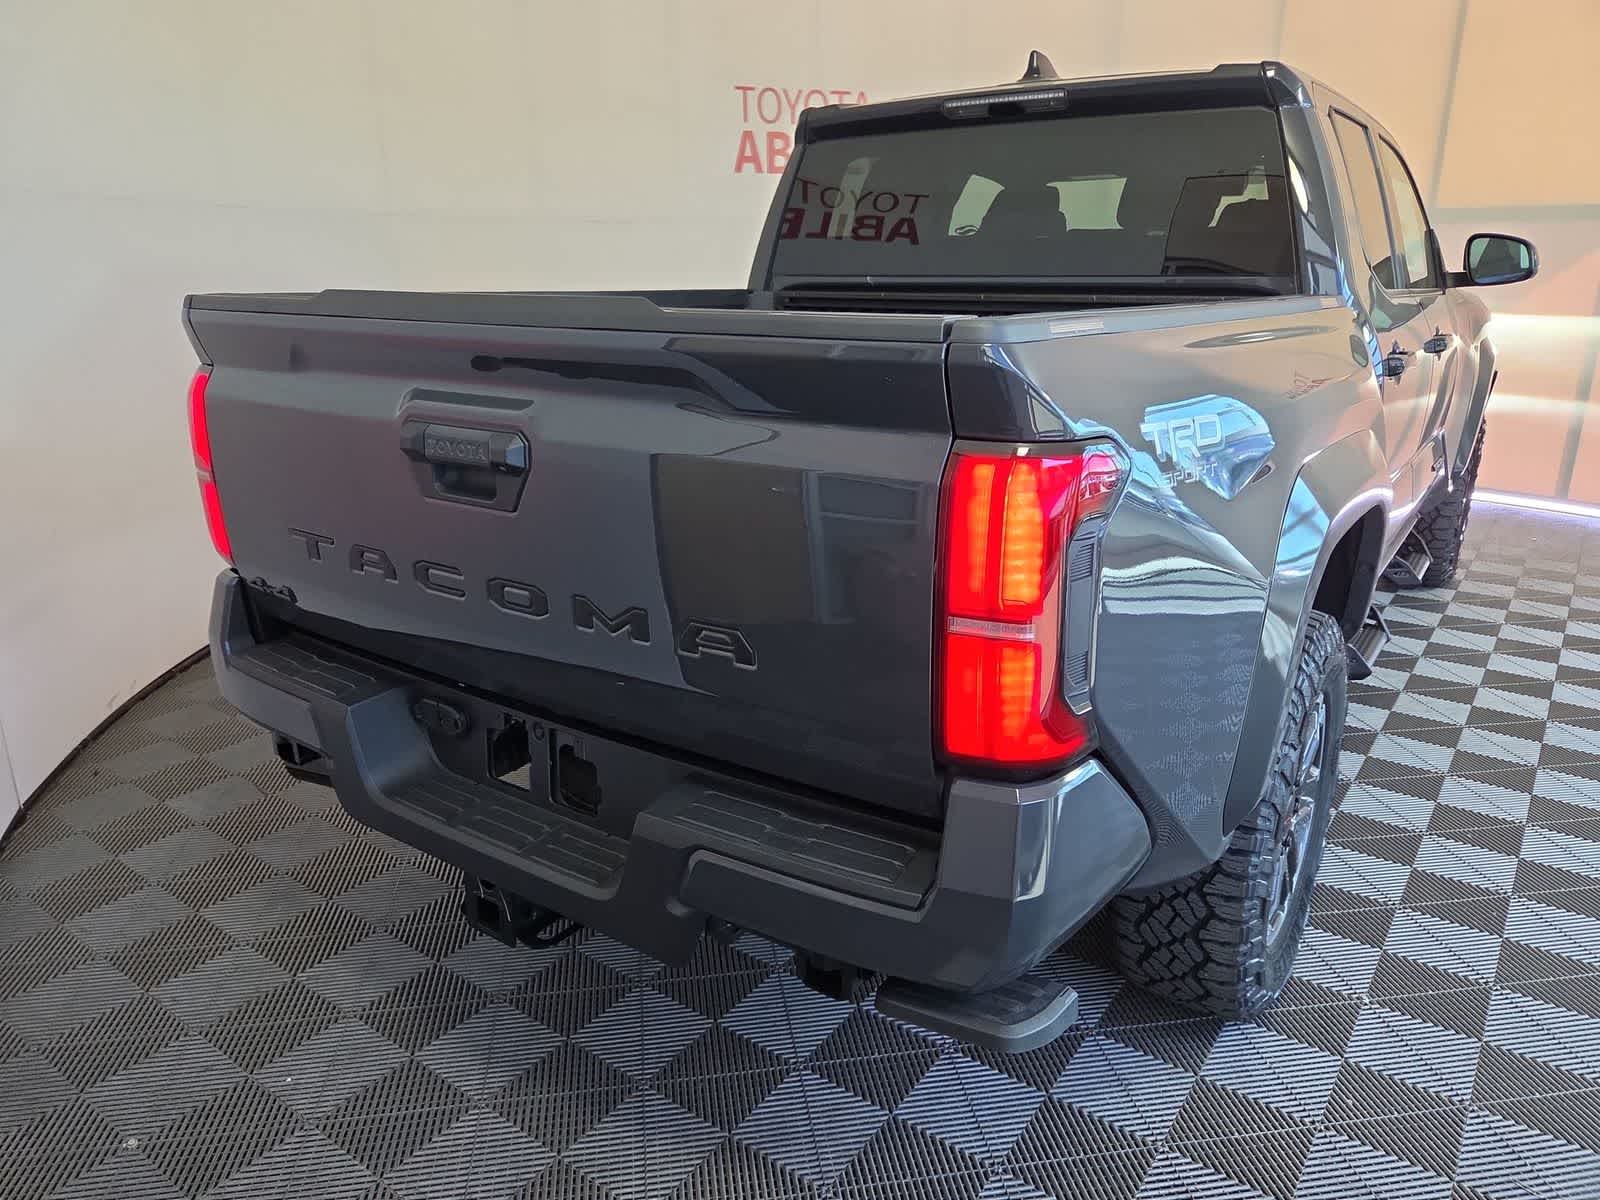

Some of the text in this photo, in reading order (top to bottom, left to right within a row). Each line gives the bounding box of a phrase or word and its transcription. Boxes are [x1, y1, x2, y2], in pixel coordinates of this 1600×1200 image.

[427, 438, 487, 461] TOYOTA
[1140, 415, 1222, 463] TRD
[288, 527, 758, 671] TACOMA
